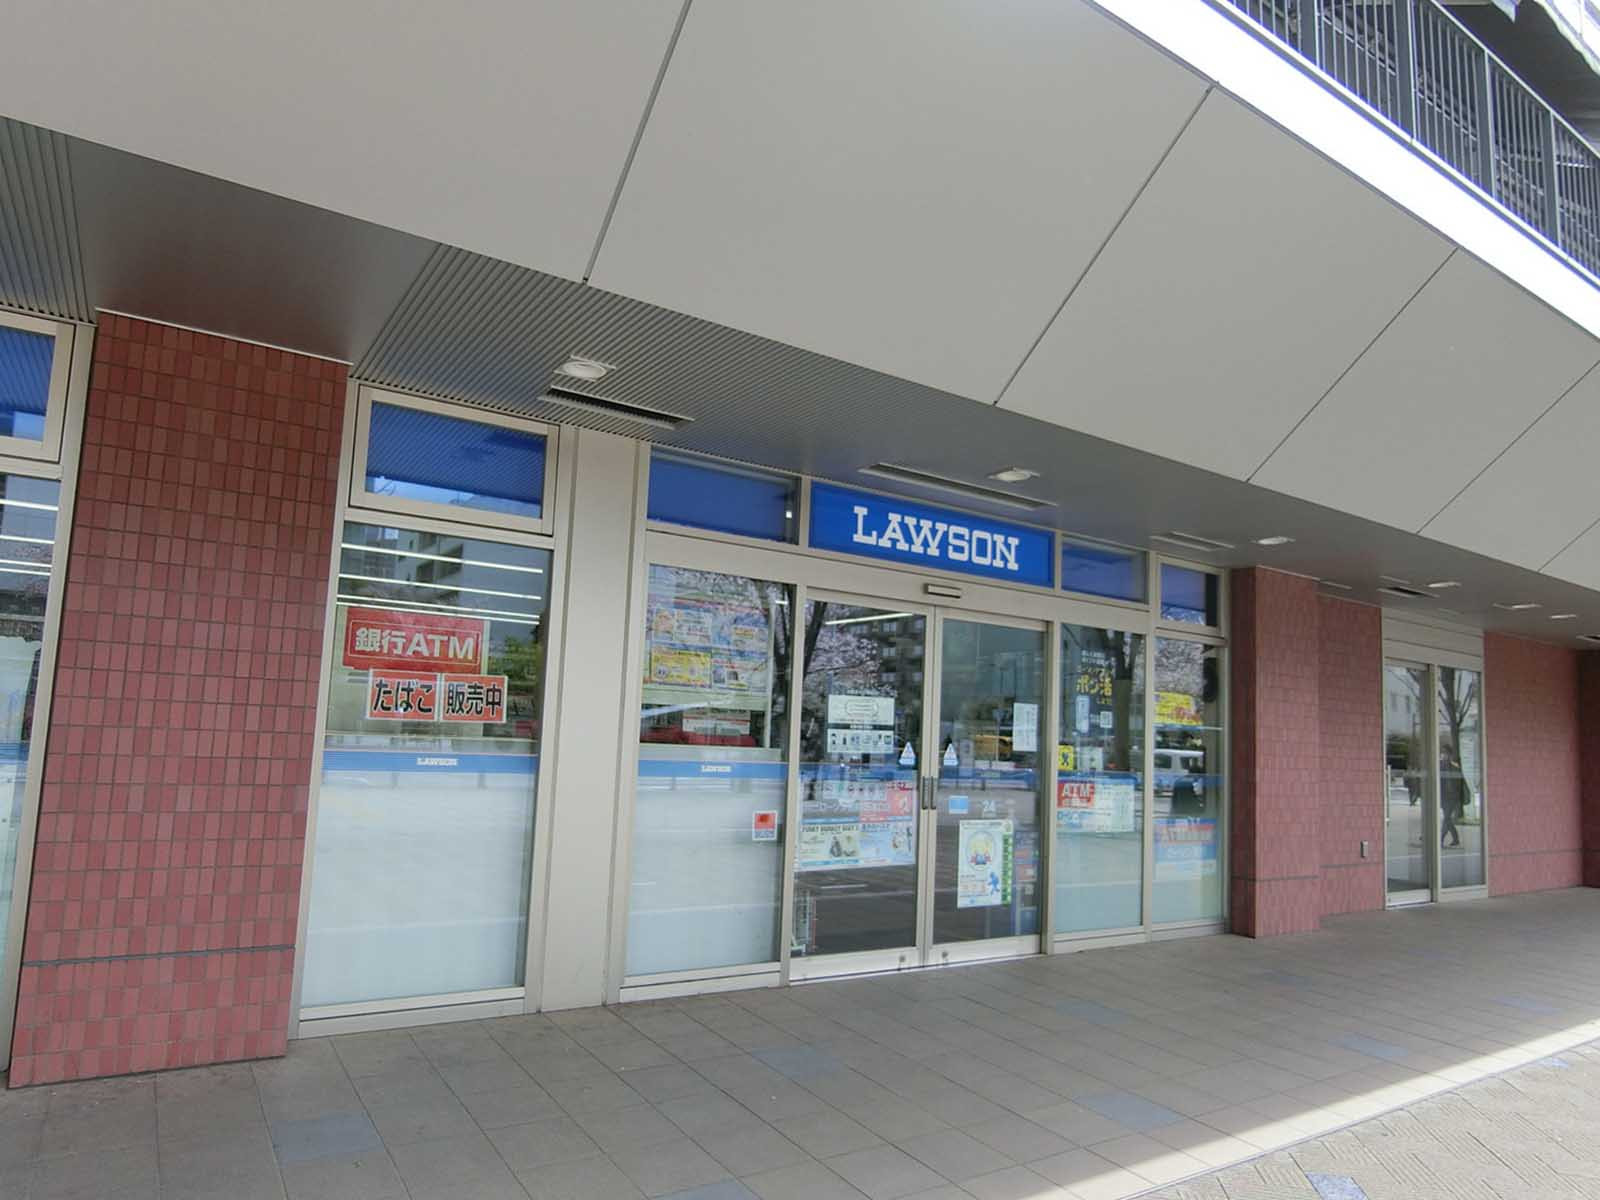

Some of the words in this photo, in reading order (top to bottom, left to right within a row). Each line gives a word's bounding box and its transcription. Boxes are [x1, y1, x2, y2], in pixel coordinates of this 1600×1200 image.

[852, 505, 1020, 571] LAWSON
[355, 627, 474, 660] 銀行ATM
[373, 679, 434, 713] たばこ
[446, 682, 503, 716] 販売中
[1062, 782, 1091, 798] ATM
